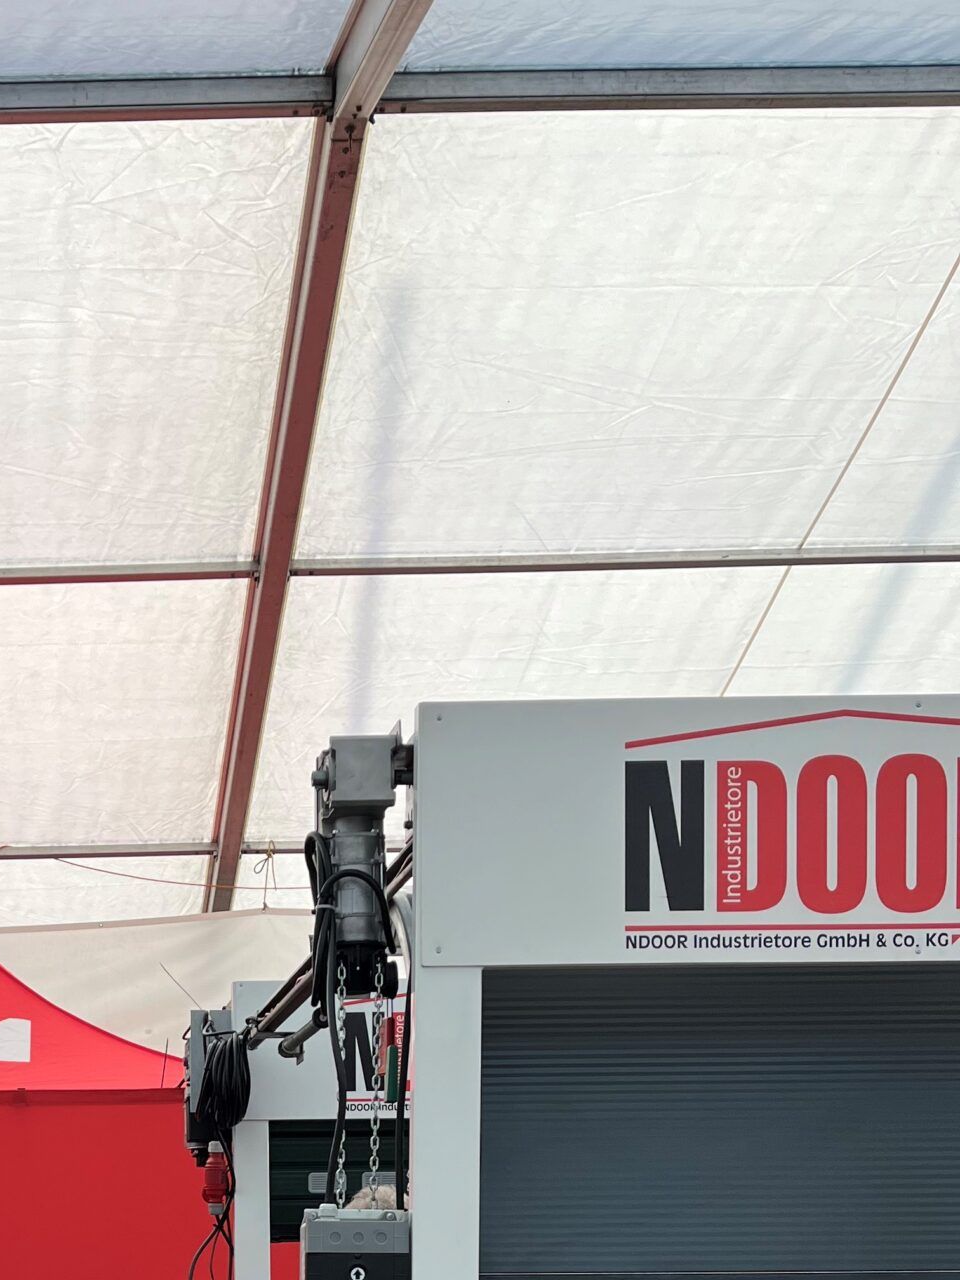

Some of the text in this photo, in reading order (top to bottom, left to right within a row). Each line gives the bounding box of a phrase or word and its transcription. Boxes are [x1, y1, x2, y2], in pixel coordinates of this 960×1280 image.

[625, 753, 960, 914] NDOO
[722, 766, 742, 904] Industrietore
[625, 932, 949, 949] NDOOR Industrietore GmbH & Co. KG
